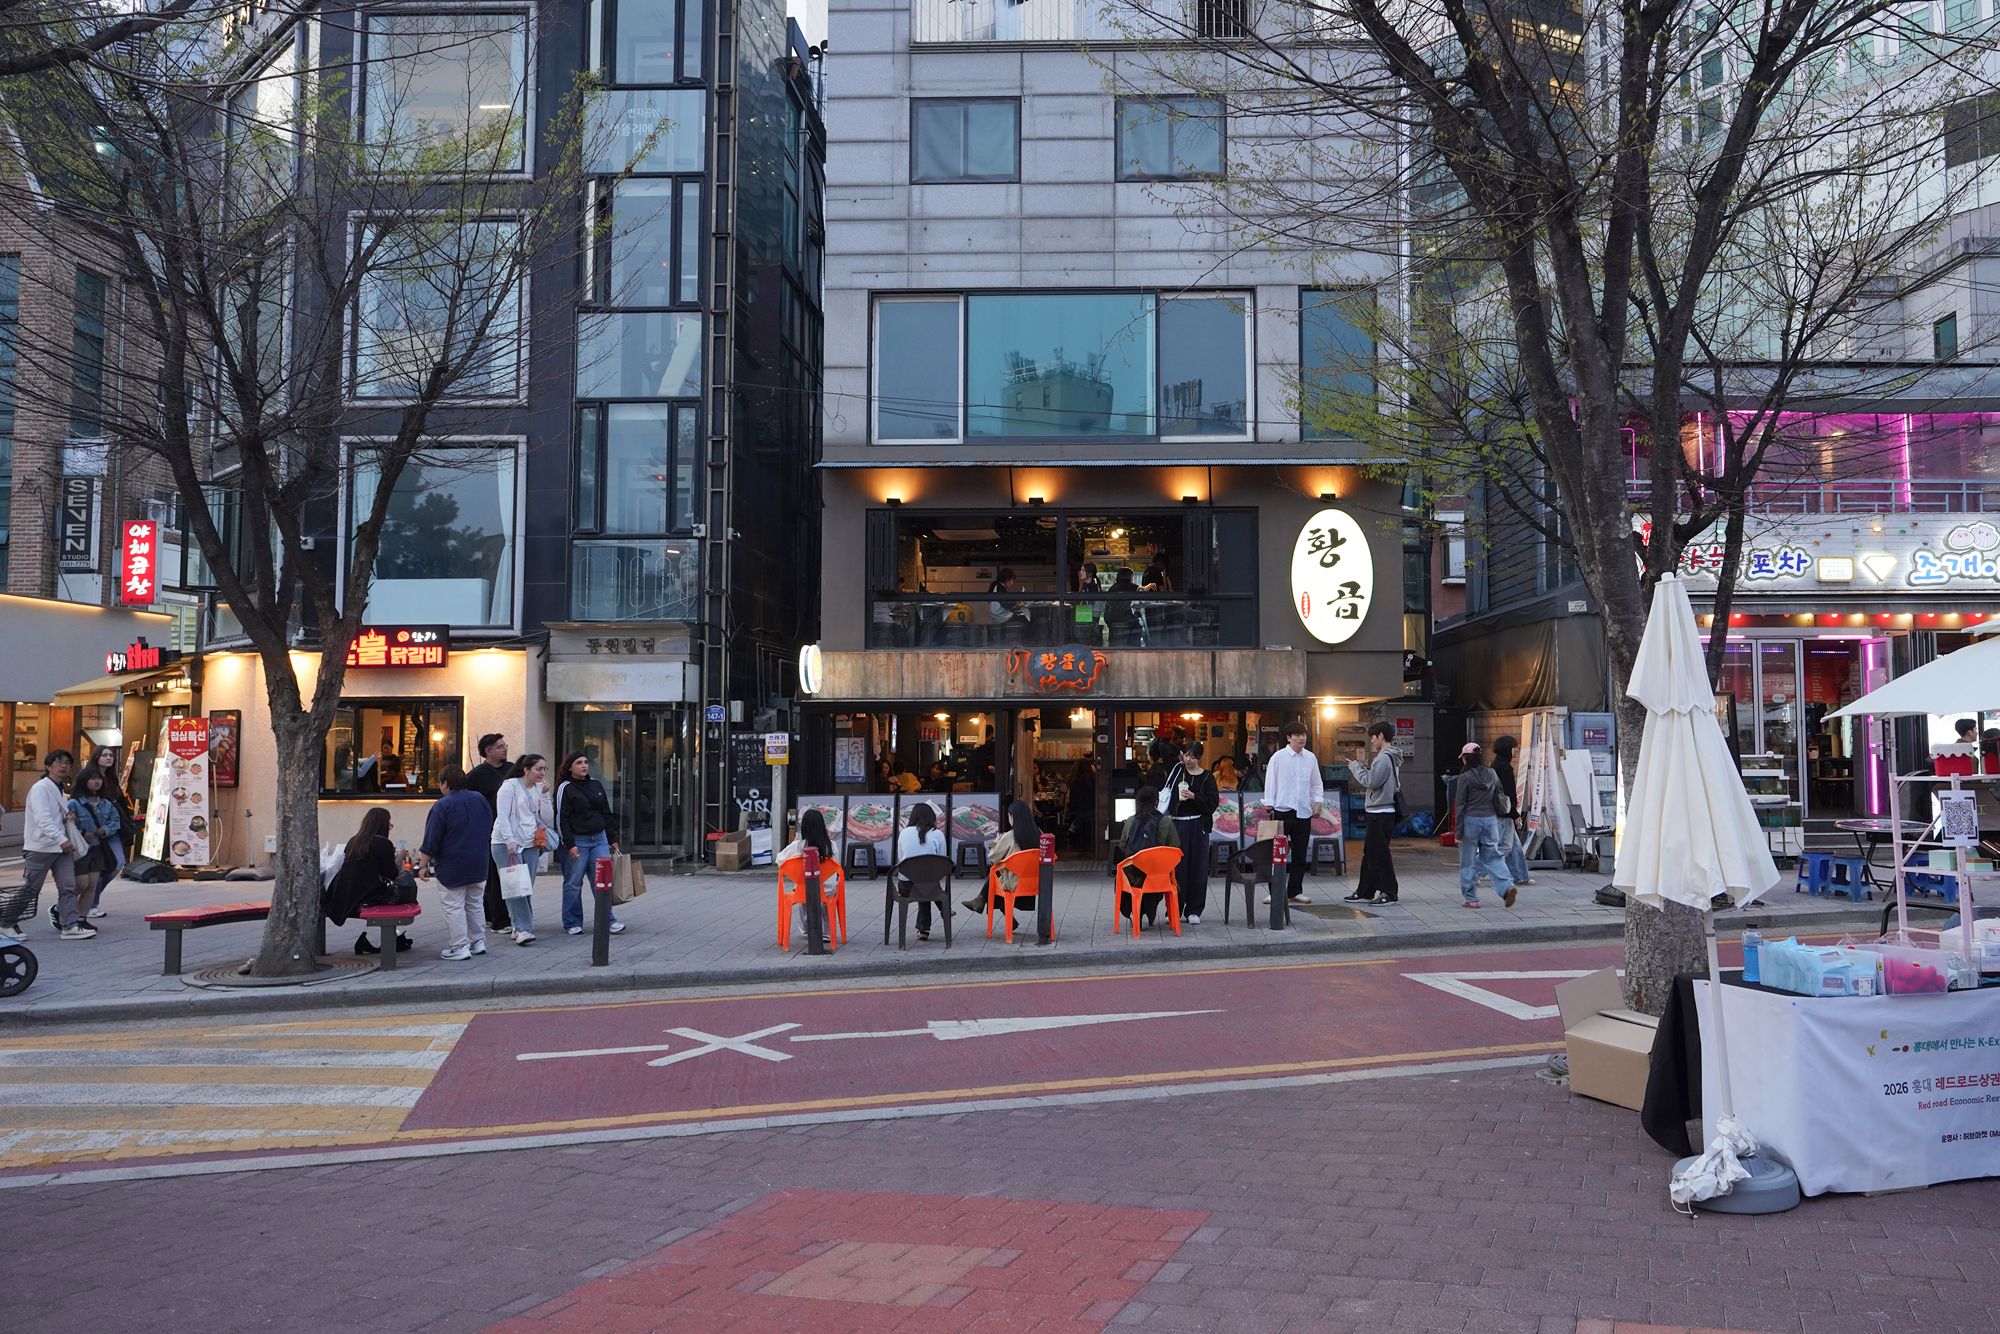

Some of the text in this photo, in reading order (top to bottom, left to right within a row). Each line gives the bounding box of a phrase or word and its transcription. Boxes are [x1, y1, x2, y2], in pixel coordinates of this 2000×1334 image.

[65, 479, 88, 551] SEVEN
[1752, 551, 1808, 575] 포차
[585, 638, 655, 654] 동원빌딩
[390, 647, 442, 664] 닭갈비
[170, 731, 206, 747] 점심특선
[1913, 1040, 1947, 1053] 홍대에서
[1950, 1038, 1976, 1050] 만나는
[1884, 1082, 1909, 1095] 2026
[1912, 1078, 1932, 1094] 홍대
[1918, 1101, 1931, 1110] Red
[1932, 1098, 1947, 1108] road
[1949, 1097, 1984, 1106] Economic
[1941, 1134, 1958, 1143] 운영사
